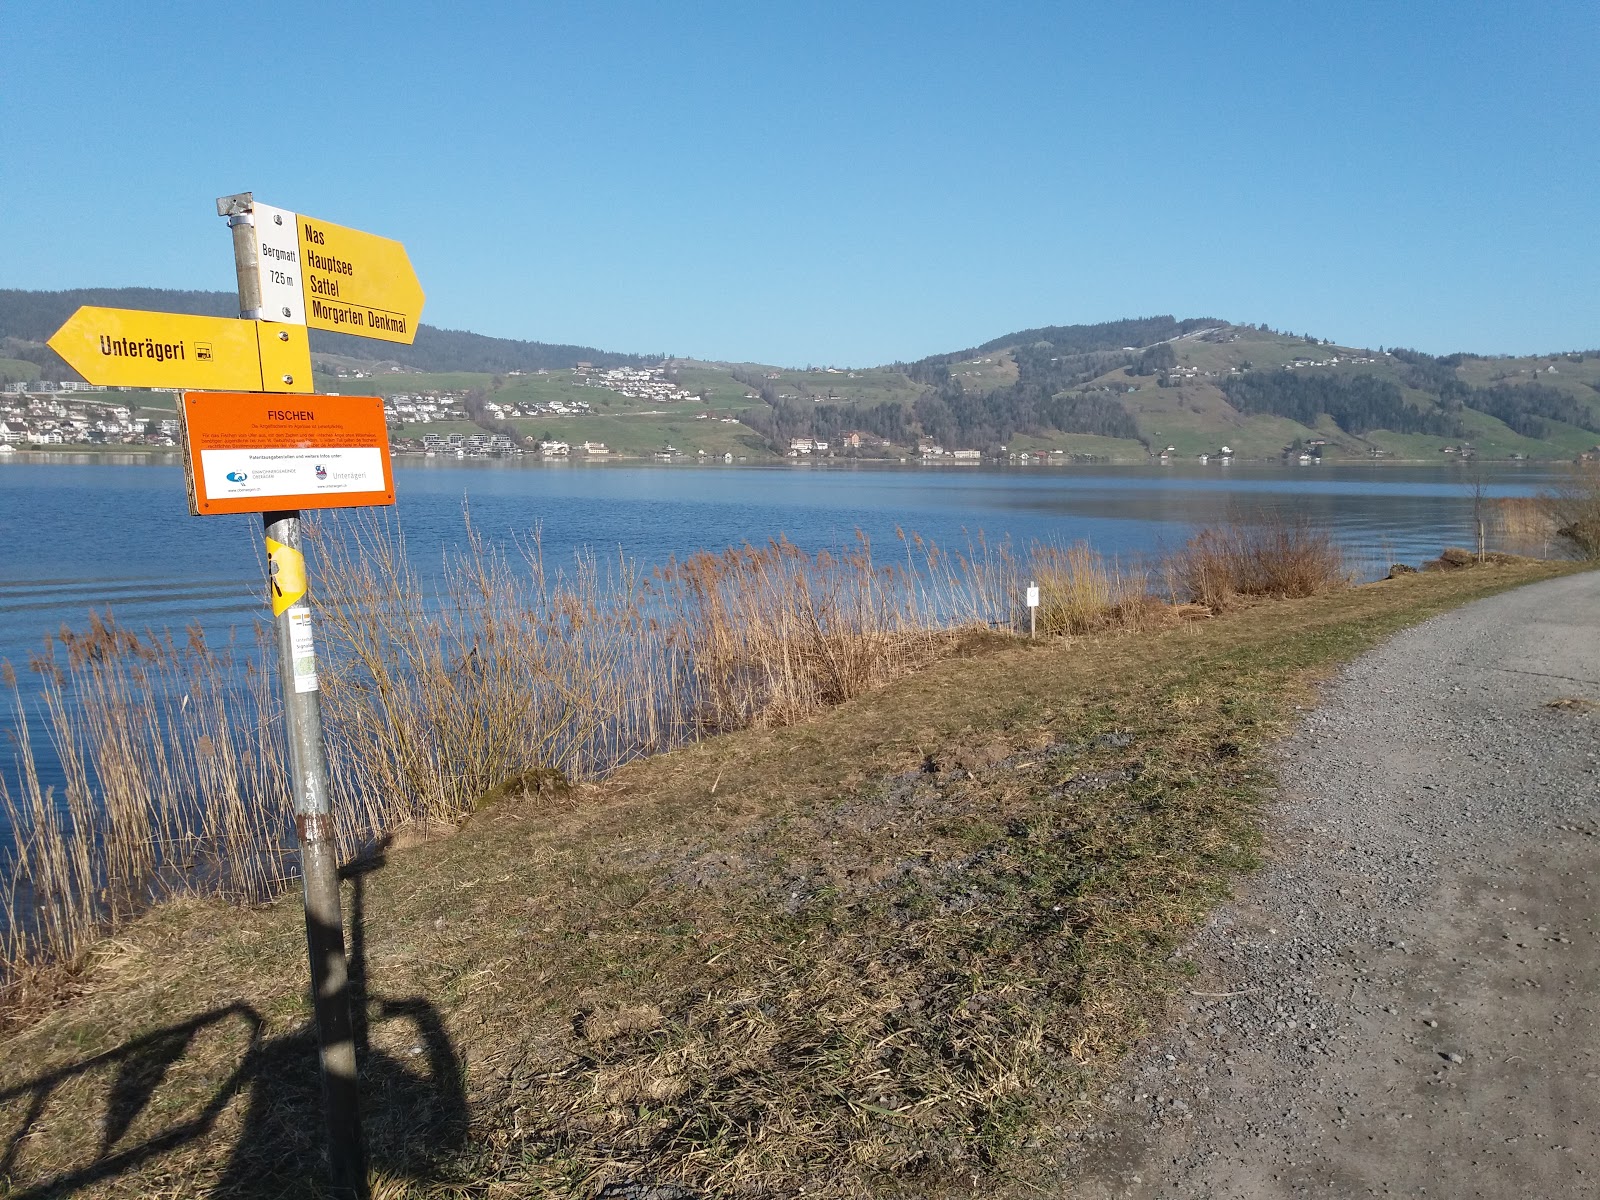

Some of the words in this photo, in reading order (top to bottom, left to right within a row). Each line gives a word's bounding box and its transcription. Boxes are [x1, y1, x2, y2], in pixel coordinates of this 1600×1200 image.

[305, 224, 325, 245] Nas
[262, 243, 296, 263] Bergmatt
[307, 249, 353, 276] Hauptsee
[270, 269, 286, 285] 725
[286, 277, 294, 287] m
[310, 274, 340, 298] Sattel
[312, 299, 364, 327] Morgarten
[368, 310, 407, 334] Denkmal
[99, 334, 185, 362] Unterägeri
[267, 410, 315, 421] FISCHEN
